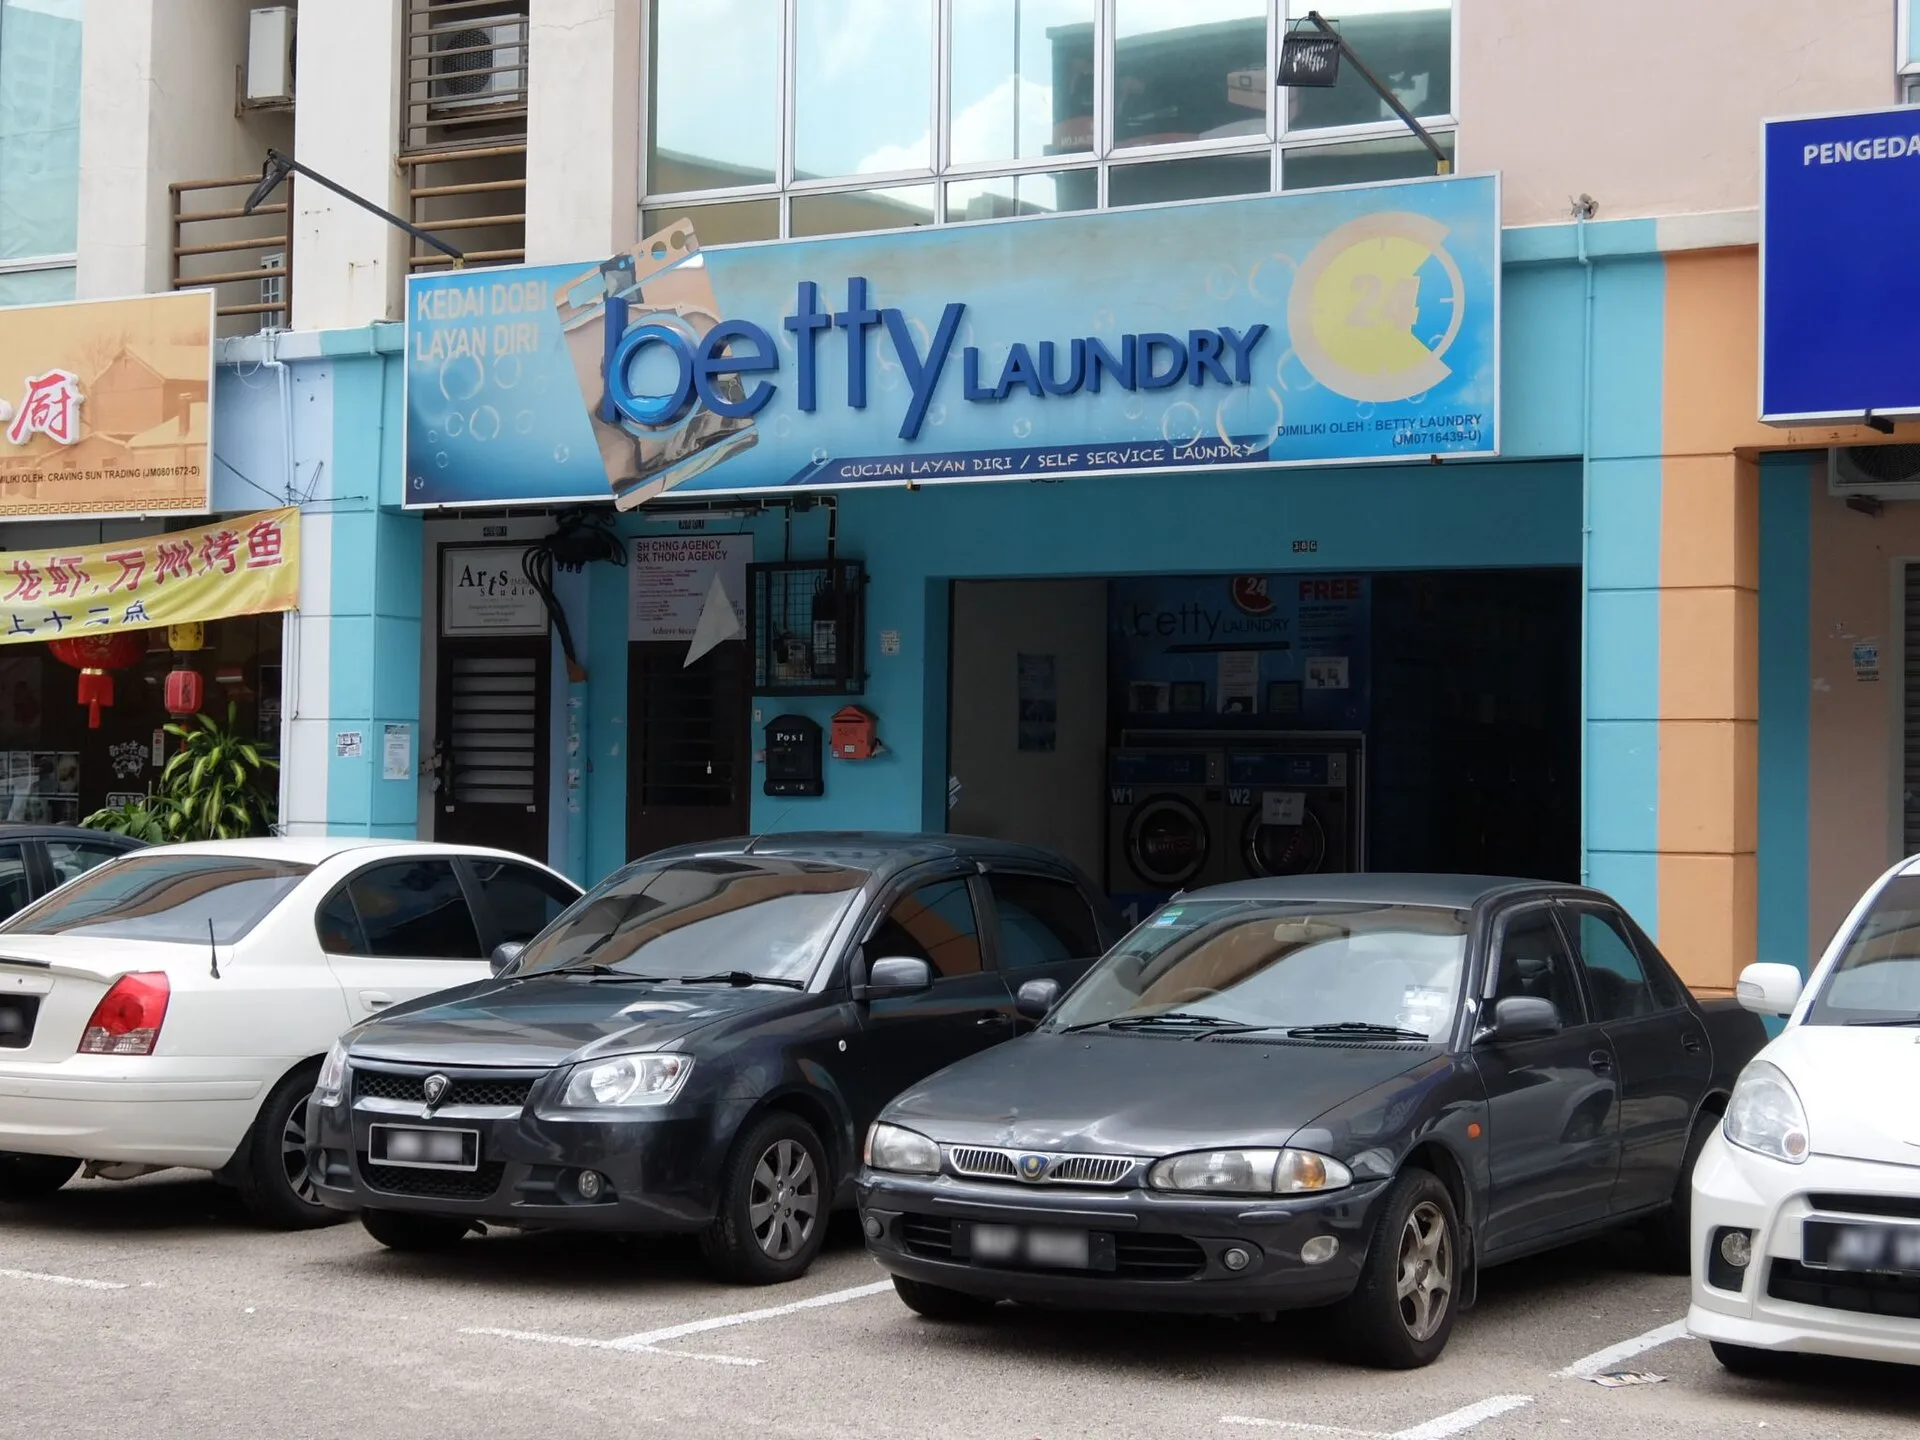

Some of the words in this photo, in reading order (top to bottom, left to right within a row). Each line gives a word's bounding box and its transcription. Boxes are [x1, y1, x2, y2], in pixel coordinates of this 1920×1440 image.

[417, 286, 484, 321] KEDAI
[492, 280, 547, 316] DOBI
[416, 326, 486, 361] LAYAN
[494, 323, 538, 356] DIRI
[602, 276, 966, 441] betty
[963, 324, 1269, 402] LAUNDRY
[8, 371, 76, 443] 厨
[1277, 423, 1326, 437] DIMILIKI
[1329, 421, 1364, 433] OLEH
[1375, 418, 1417, 431] BETTY
[1420, 414, 1482, 428] LAUNDRY
[840, 463, 904, 477] CUCIAN
[910, 459, 966, 474] LAYAN
[973, 456, 1012, 470] DIRI
[1019, 454, 1031, 469] /
[1038, 453, 1079, 468] SELF
[1086, 448, 1165, 465] SERVICE
[1173, 443, 1257, 460] LAUNDRY
[47, 471, 83, 482] CRAVING
[85, 470, 102, 481] SUN
[104, 468, 141, 480] TRADING
[637, 542, 650, 552] SH
[681, 539, 722, 550] AGENCY
[637, 553, 650, 562] SK
[652, 551, 685, 562] THONG
[687, 550, 728, 561] AGENCY
[458, 565, 508, 595] Arts
[1246, 577, 1267, 597] 24
[1299, 579, 1360, 601] FREE
[8, 599, 150, 635] 上十二点
[1222, 618, 1290, 634] LAUNDRY
[776, 732, 803, 742] Post
[1111, 788, 1133, 803] W1
[1228, 788, 1250, 804] W2
